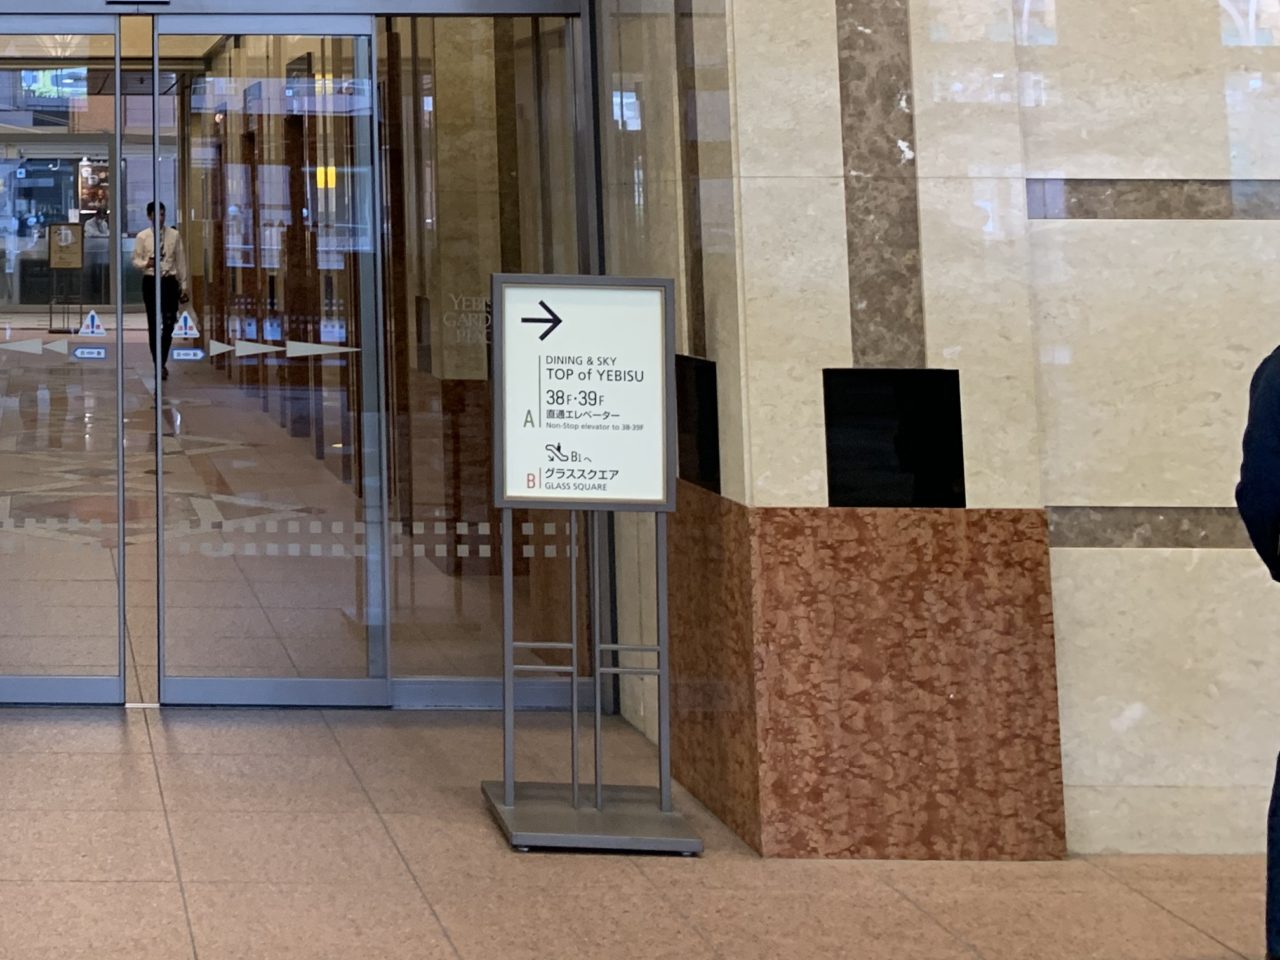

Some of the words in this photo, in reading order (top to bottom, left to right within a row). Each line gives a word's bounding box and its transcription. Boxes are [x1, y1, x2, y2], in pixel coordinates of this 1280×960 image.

[449, 293, 491, 311] YEBIS
[443, 311, 491, 327] GARD
[545, 355, 583, 365] DINING
[586, 356, 594, 366] &
[597, 356, 617, 366] SKY
[546, 368, 574, 380] TOP
[578, 368, 592, 381] of
[597, 369, 645, 382] YEBISU
[523, 409, 535, 428] A
[546, 409, 620, 420] 直通エレベーター
[581, 423, 610, 431] elevator
[545, 467, 619, 480] グラススクエア
[526, 472, 536, 489] B
[545, 482, 571, 490] GLASS
[573, 483, 607, 492] SQUARE
